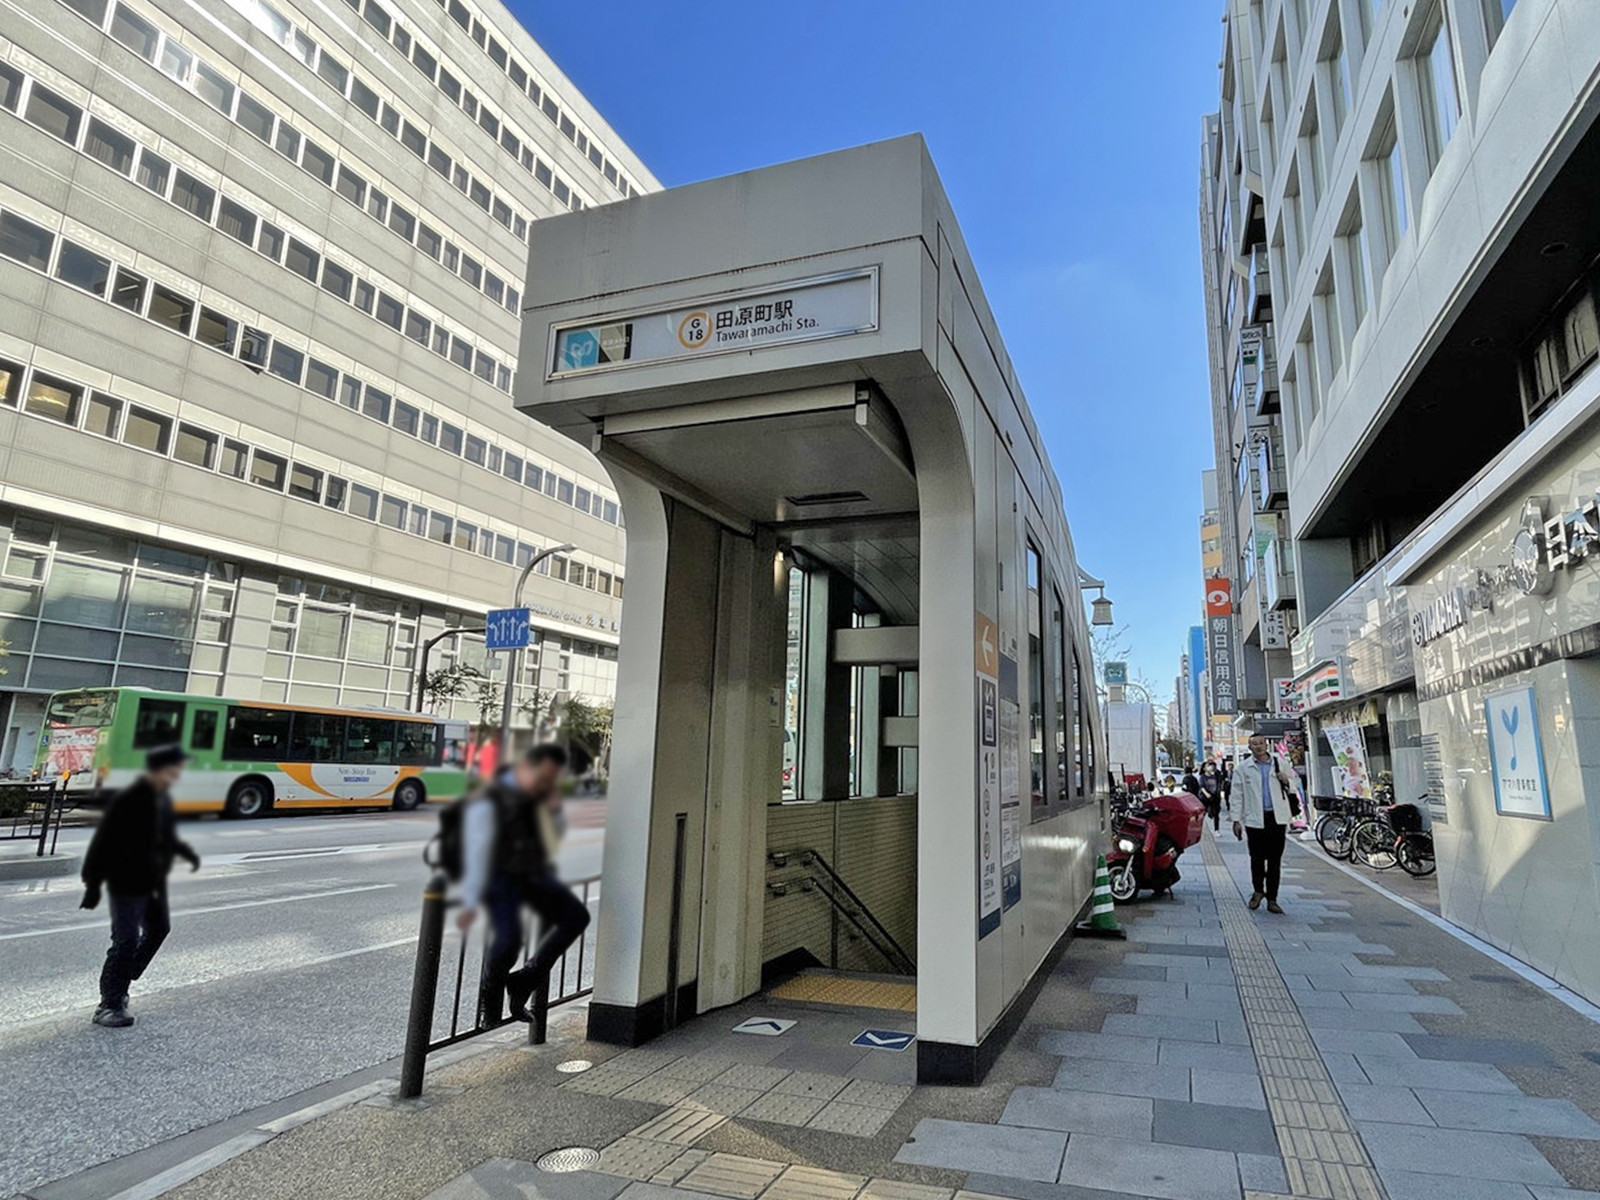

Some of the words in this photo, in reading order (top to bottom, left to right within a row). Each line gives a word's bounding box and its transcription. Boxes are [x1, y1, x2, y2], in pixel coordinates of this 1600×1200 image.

[691, 318, 701, 329] G
[715, 300, 794, 330] 田原町駅
[688, 329, 704, 341] 18
[715, 319, 793, 343] Tawaramachi
[796, 316, 820, 330] Sta.
[1212, 617, 1234, 712] 朝日信用金庫
